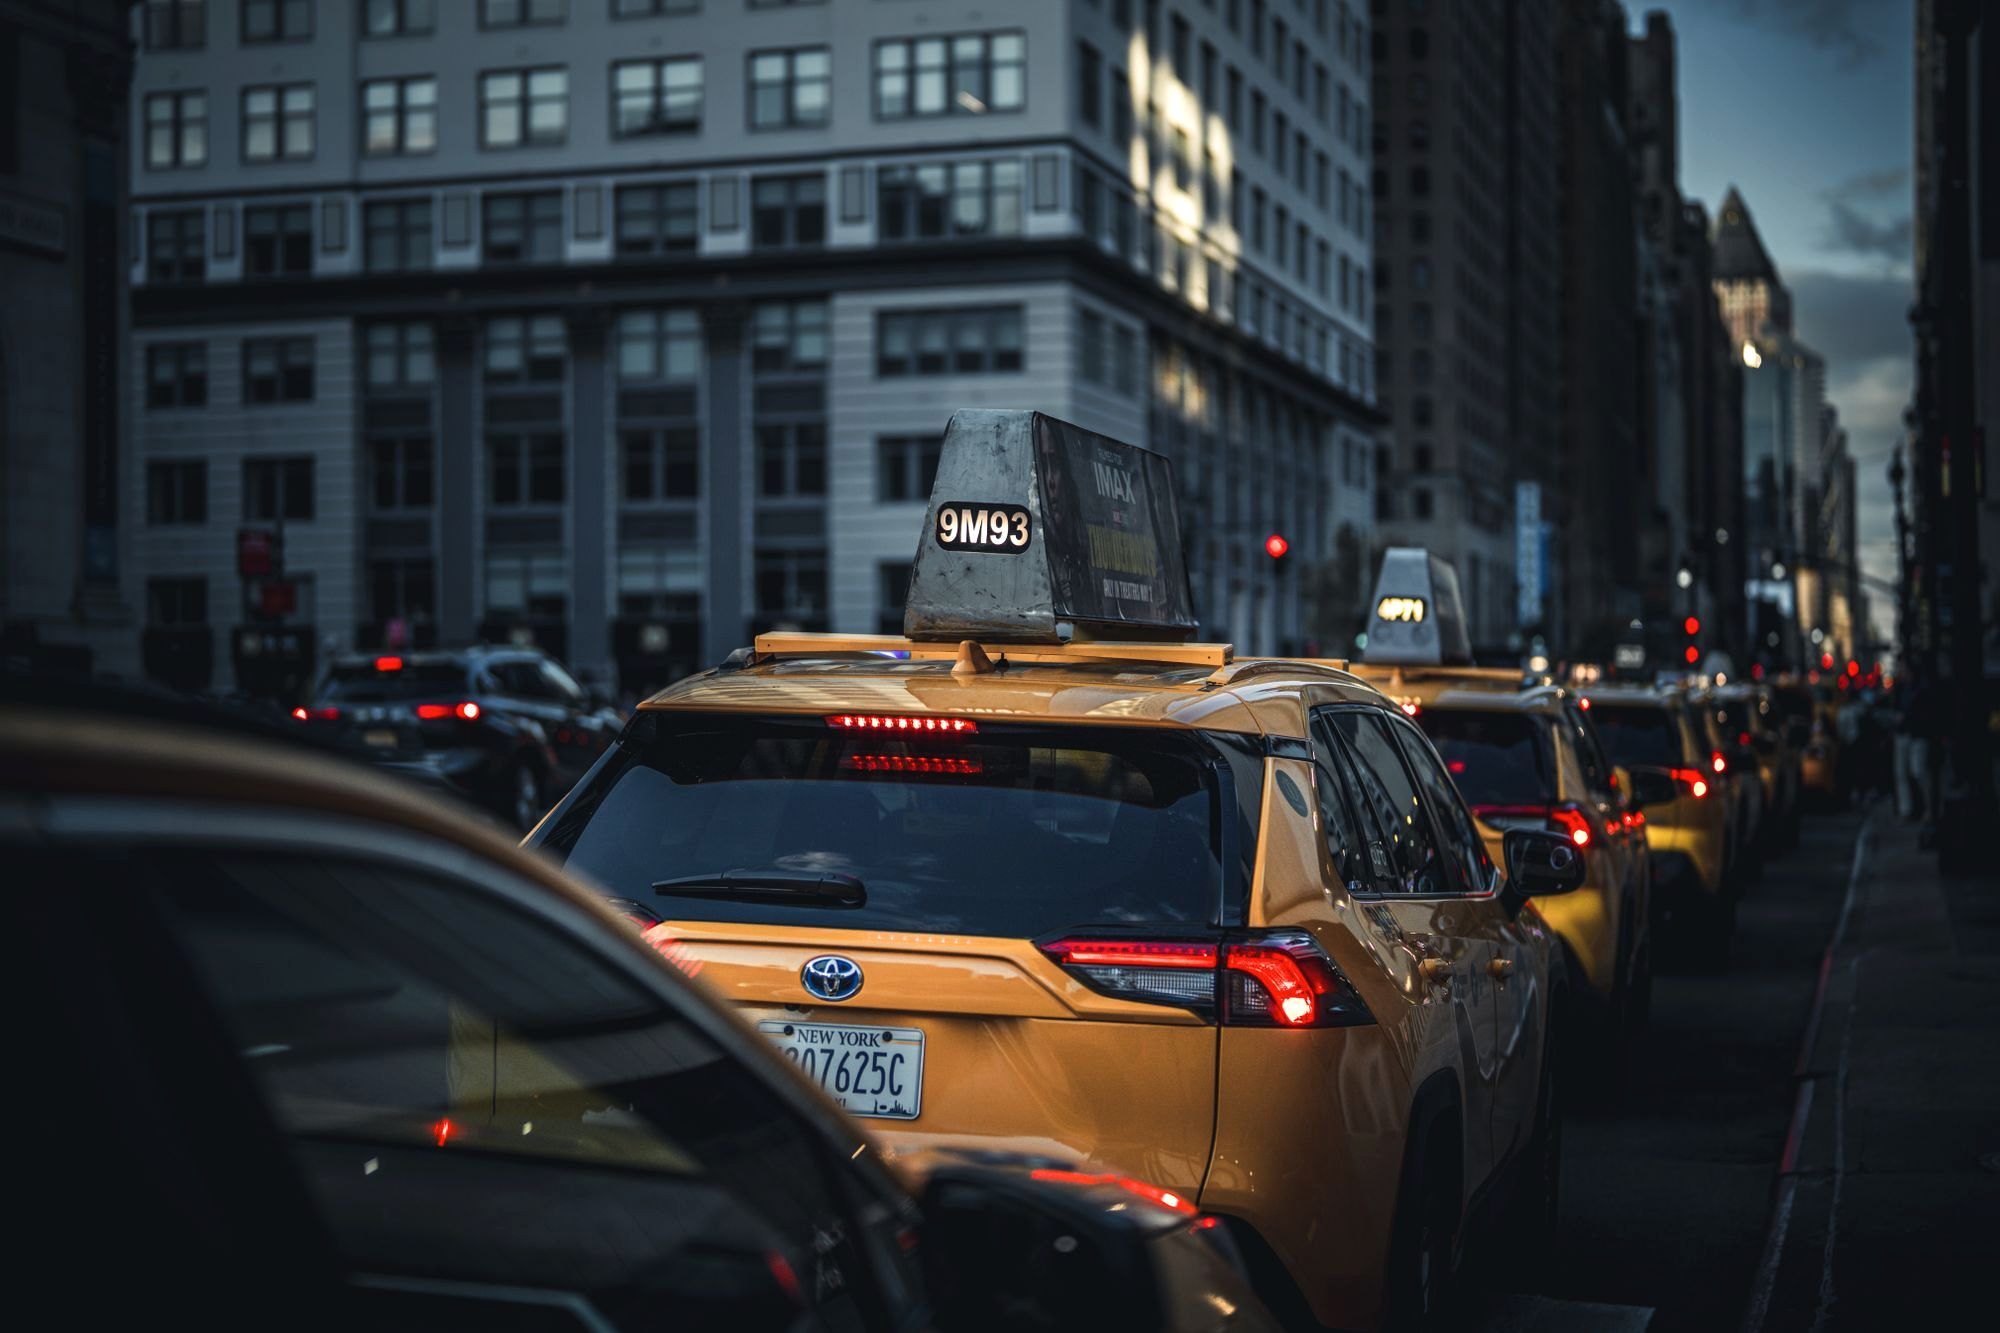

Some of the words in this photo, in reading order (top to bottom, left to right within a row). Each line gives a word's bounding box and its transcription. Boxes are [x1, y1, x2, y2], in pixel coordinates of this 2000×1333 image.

[1093, 462, 1136, 504] IMAX
[940, 508, 1029, 547] 9M93
[797, 1029, 835, 1045] NEW
[838, 1031, 880, 1048] YORK
[778, 1046, 905, 1096] 07625C
